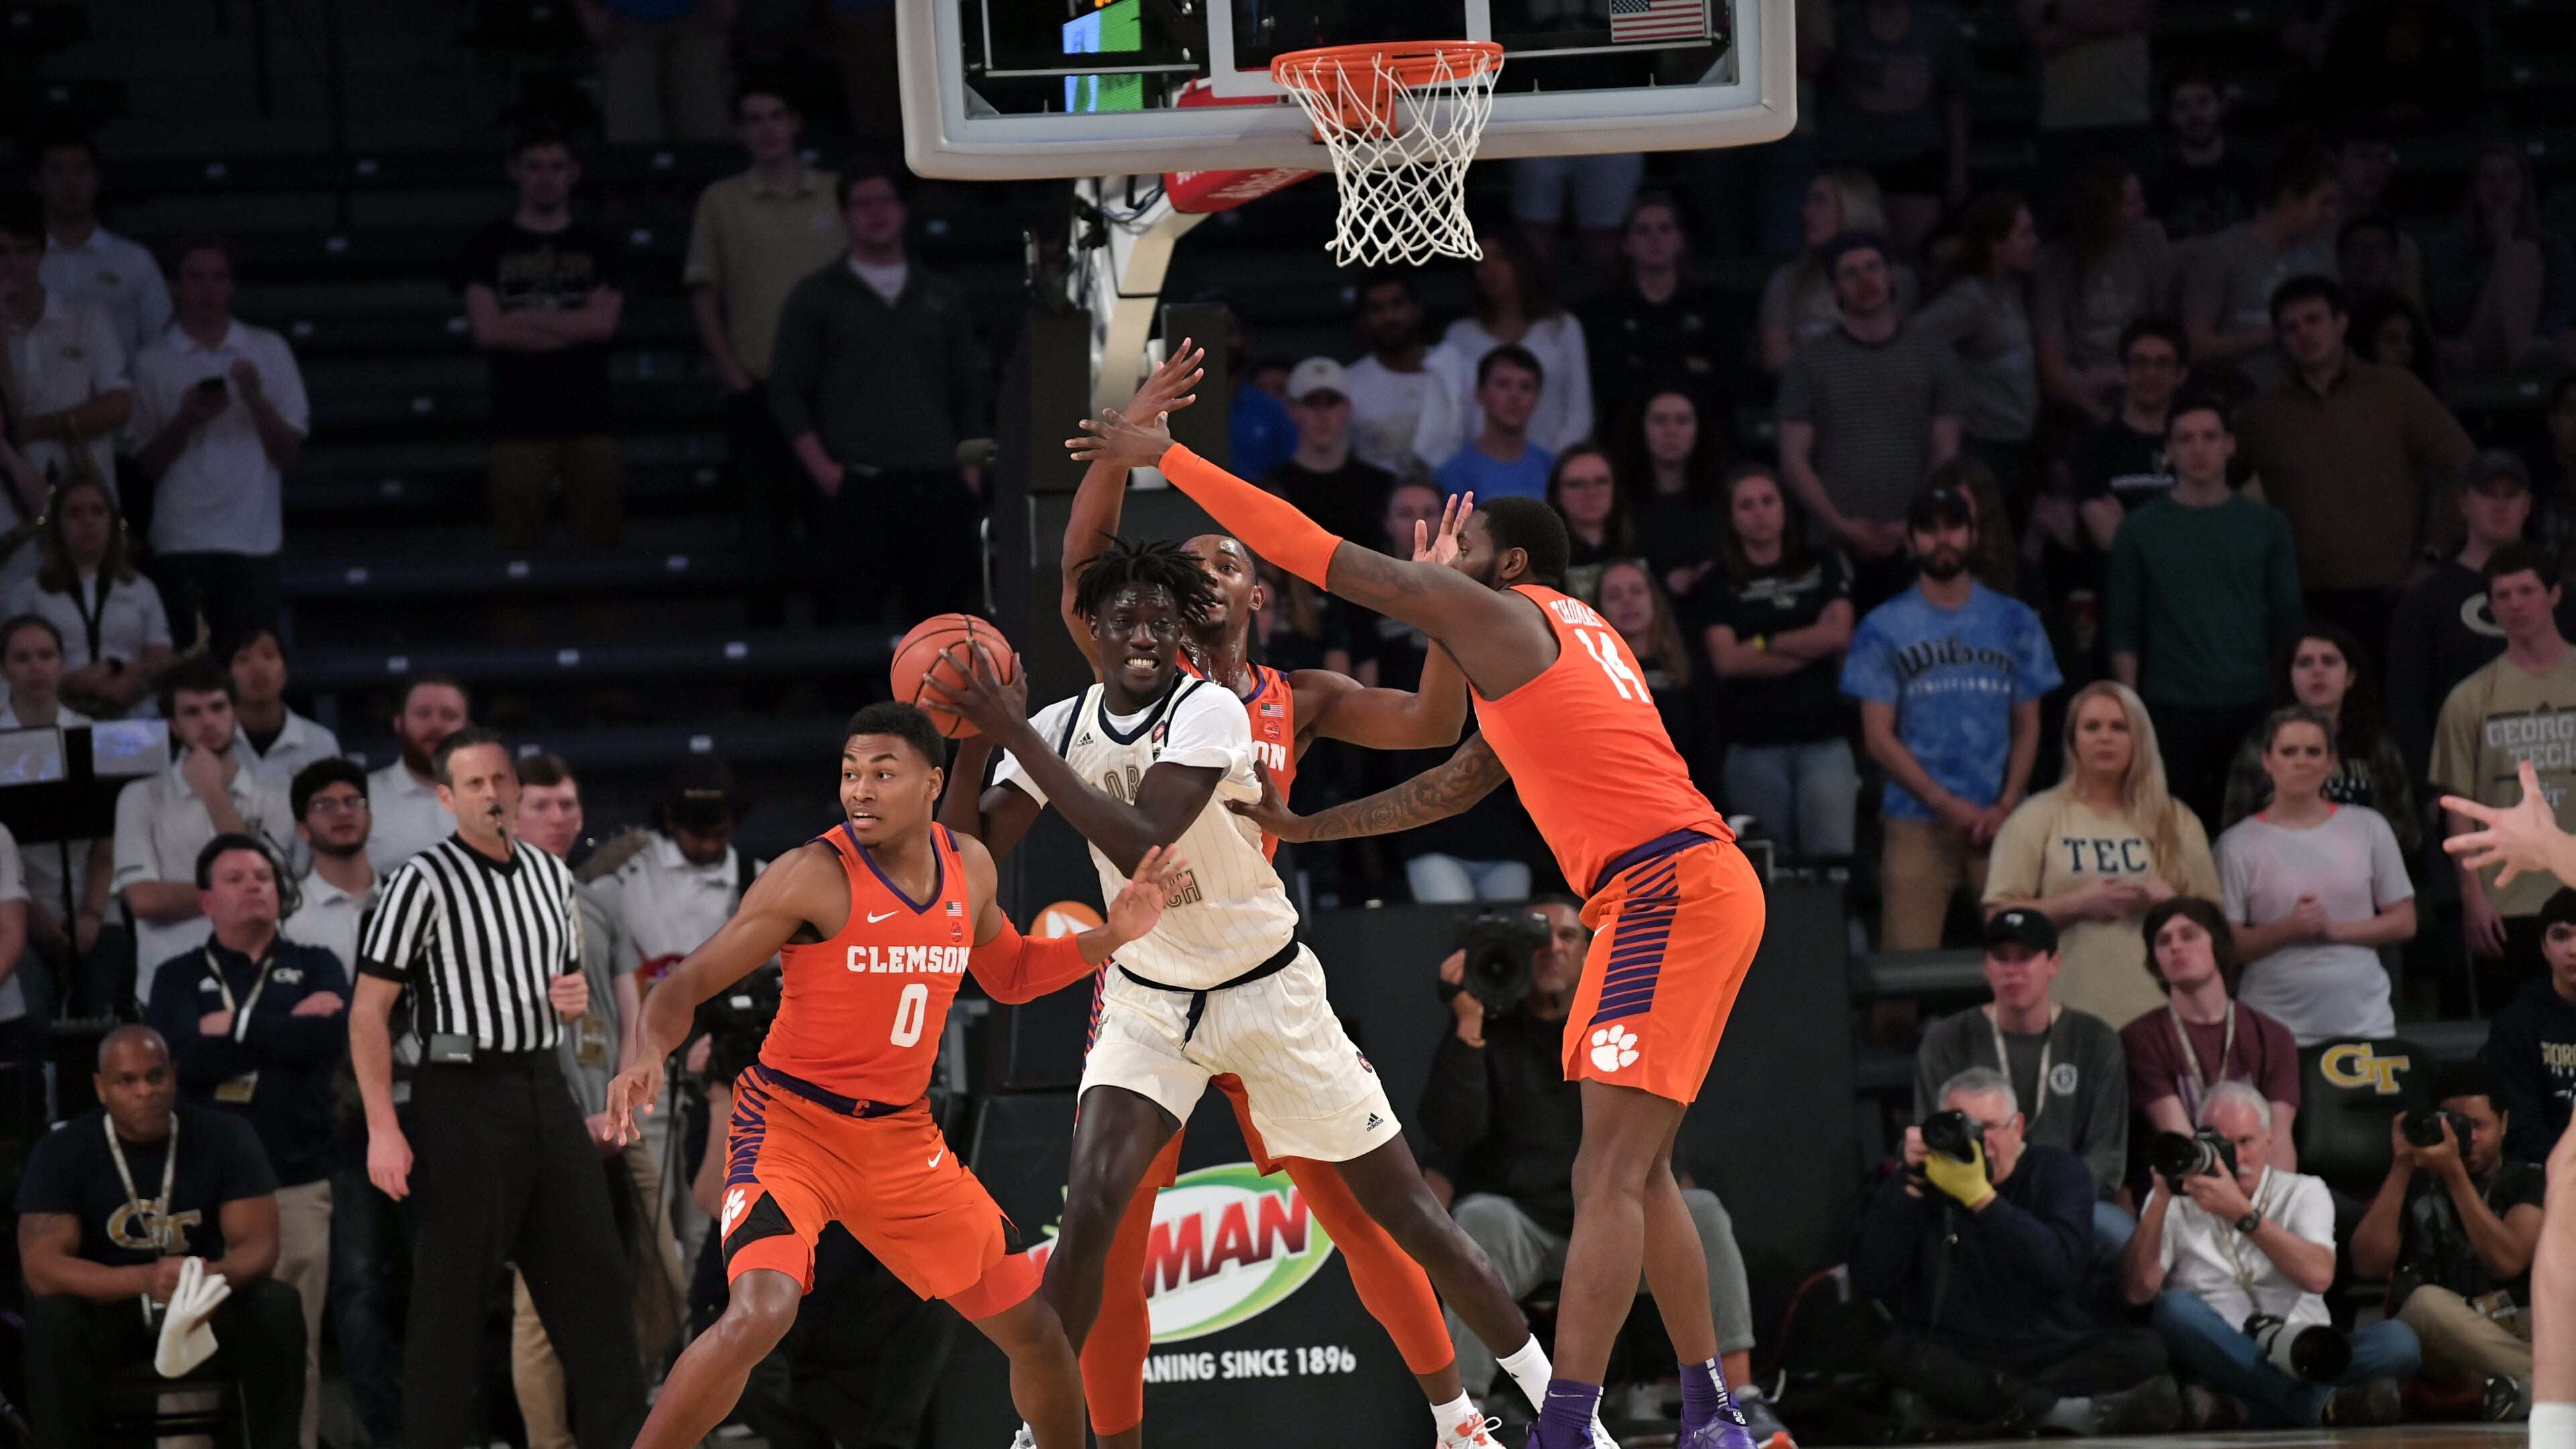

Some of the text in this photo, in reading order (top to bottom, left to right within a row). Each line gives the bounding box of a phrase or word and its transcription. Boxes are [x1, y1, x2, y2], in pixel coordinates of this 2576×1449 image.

[1549, 598, 1603, 628] THOMAS
[1574, 628, 1652, 704] 14
[1898, 635, 2013, 678] Wilson
[847, 945, 971, 973] CLEMSON
[890, 983, 929, 1048] 0
[2320, 1042, 2411, 1096] GT
[1366, 1118, 1385, 1132] adidas
[1142, 1344, 1358, 1384] ANING SINCE 1896
